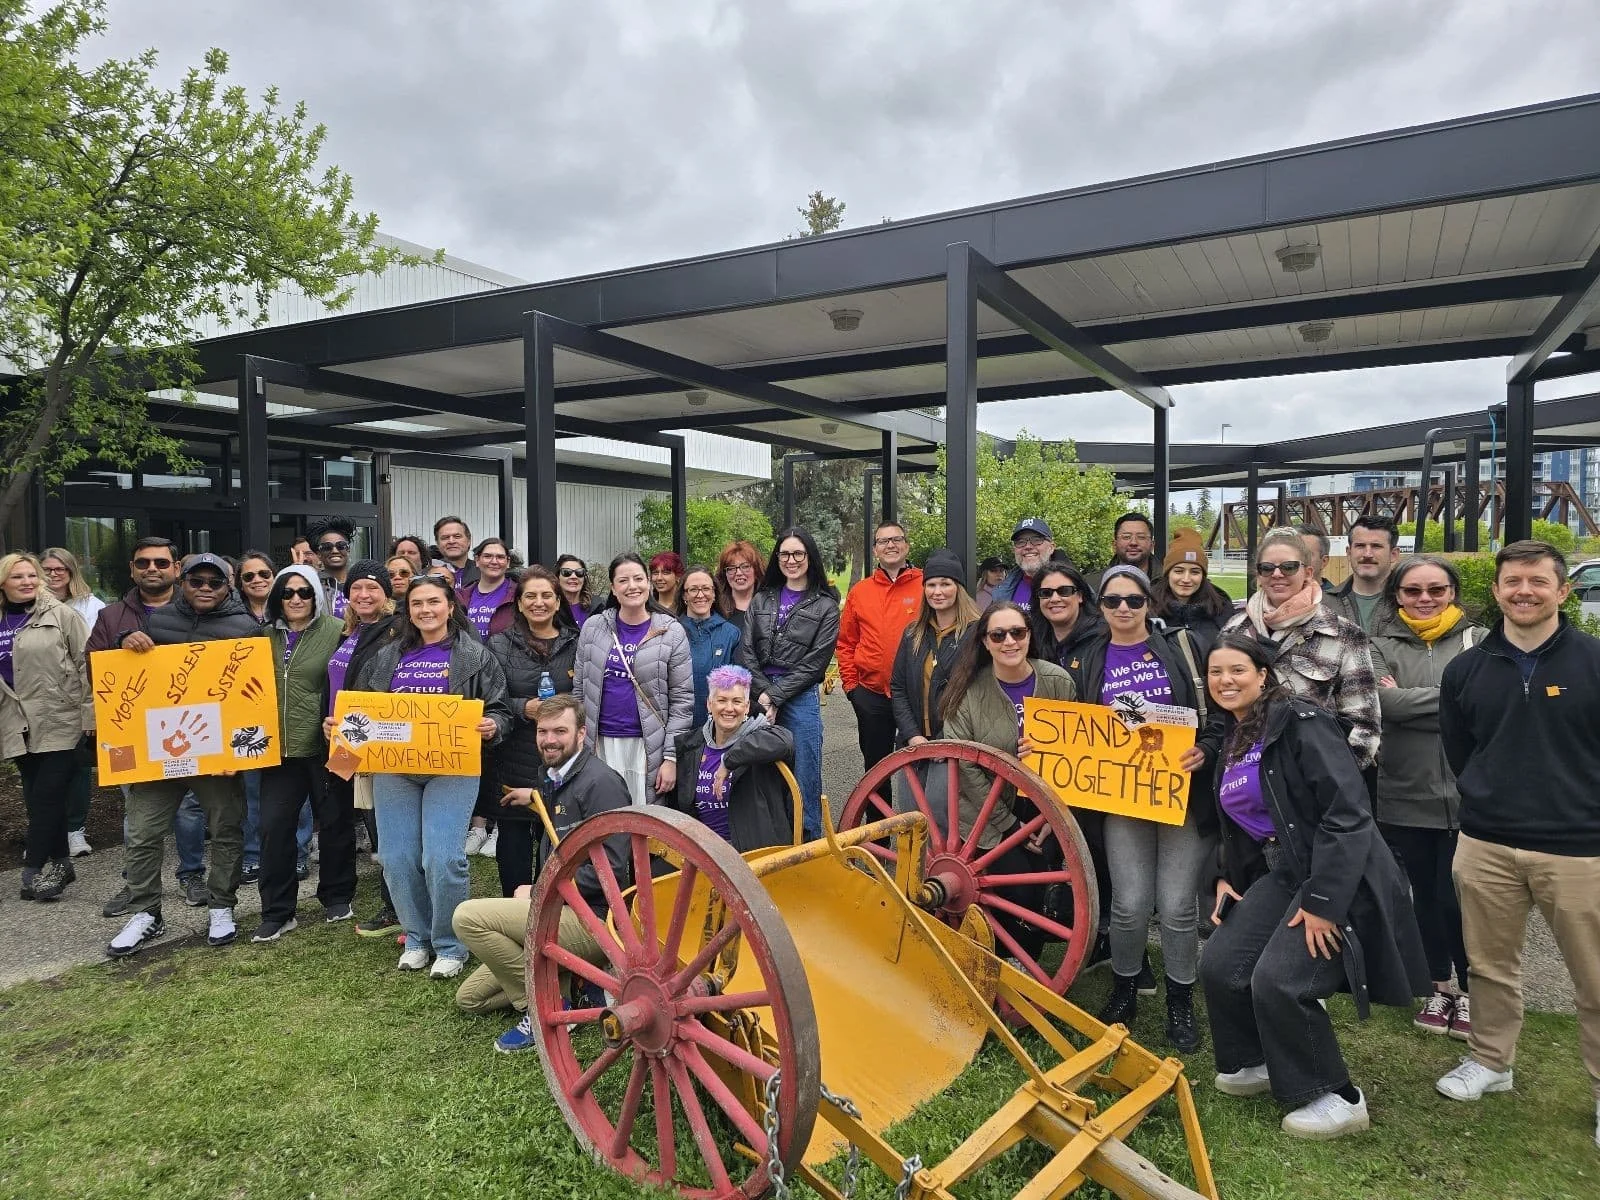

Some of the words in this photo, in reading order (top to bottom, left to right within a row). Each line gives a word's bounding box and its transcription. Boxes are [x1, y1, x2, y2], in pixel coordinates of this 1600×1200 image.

[167, 643, 207, 704] STOLEN
[207, 641, 255, 702] SISTERS
[397, 671, 411, 679] for
[413, 671, 443, 679] Good
[1111, 666, 1130, 678] We
[1131, 661, 1159, 671] Give
[1133, 672, 1154, 684] We
[96, 671, 116, 703] NO
[1138, 686, 1172, 698] ELUS
[110, 669, 148, 731] MORE
[379, 697, 430, 719] JOIN
[420, 722, 468, 748] THE
[1028, 708, 1132, 748] STAND
[366, 746, 470, 770] MOVEMENT
[698, 770, 713, 780] We
[1030, 750, 1184, 811] TOGETHER
[1228, 775, 1248, 791] TELUS
